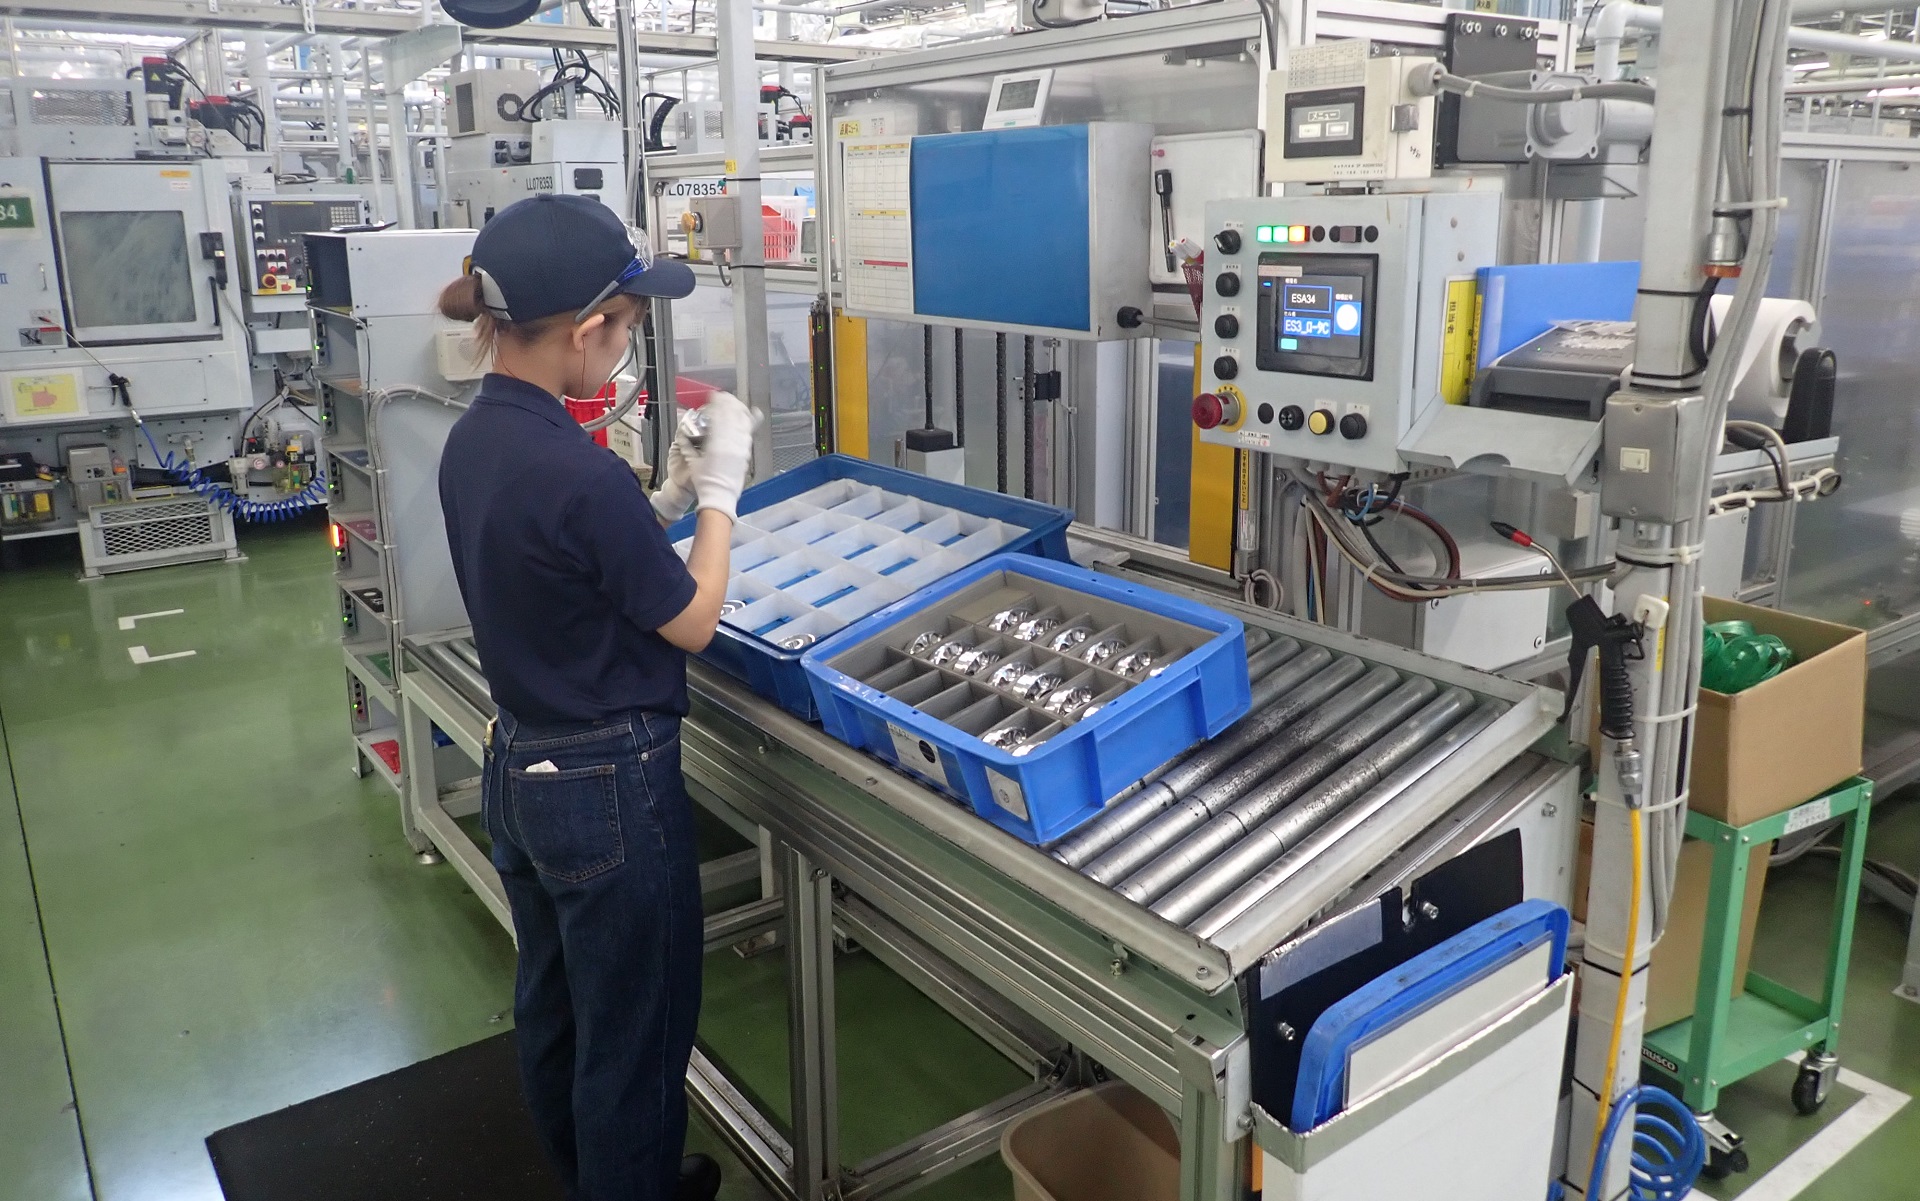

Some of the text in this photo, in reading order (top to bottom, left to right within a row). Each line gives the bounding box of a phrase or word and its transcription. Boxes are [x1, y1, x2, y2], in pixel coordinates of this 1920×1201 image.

[1311, 111, 1337, 120] メニュー
[1291, 293, 1316, 304] ESA34
